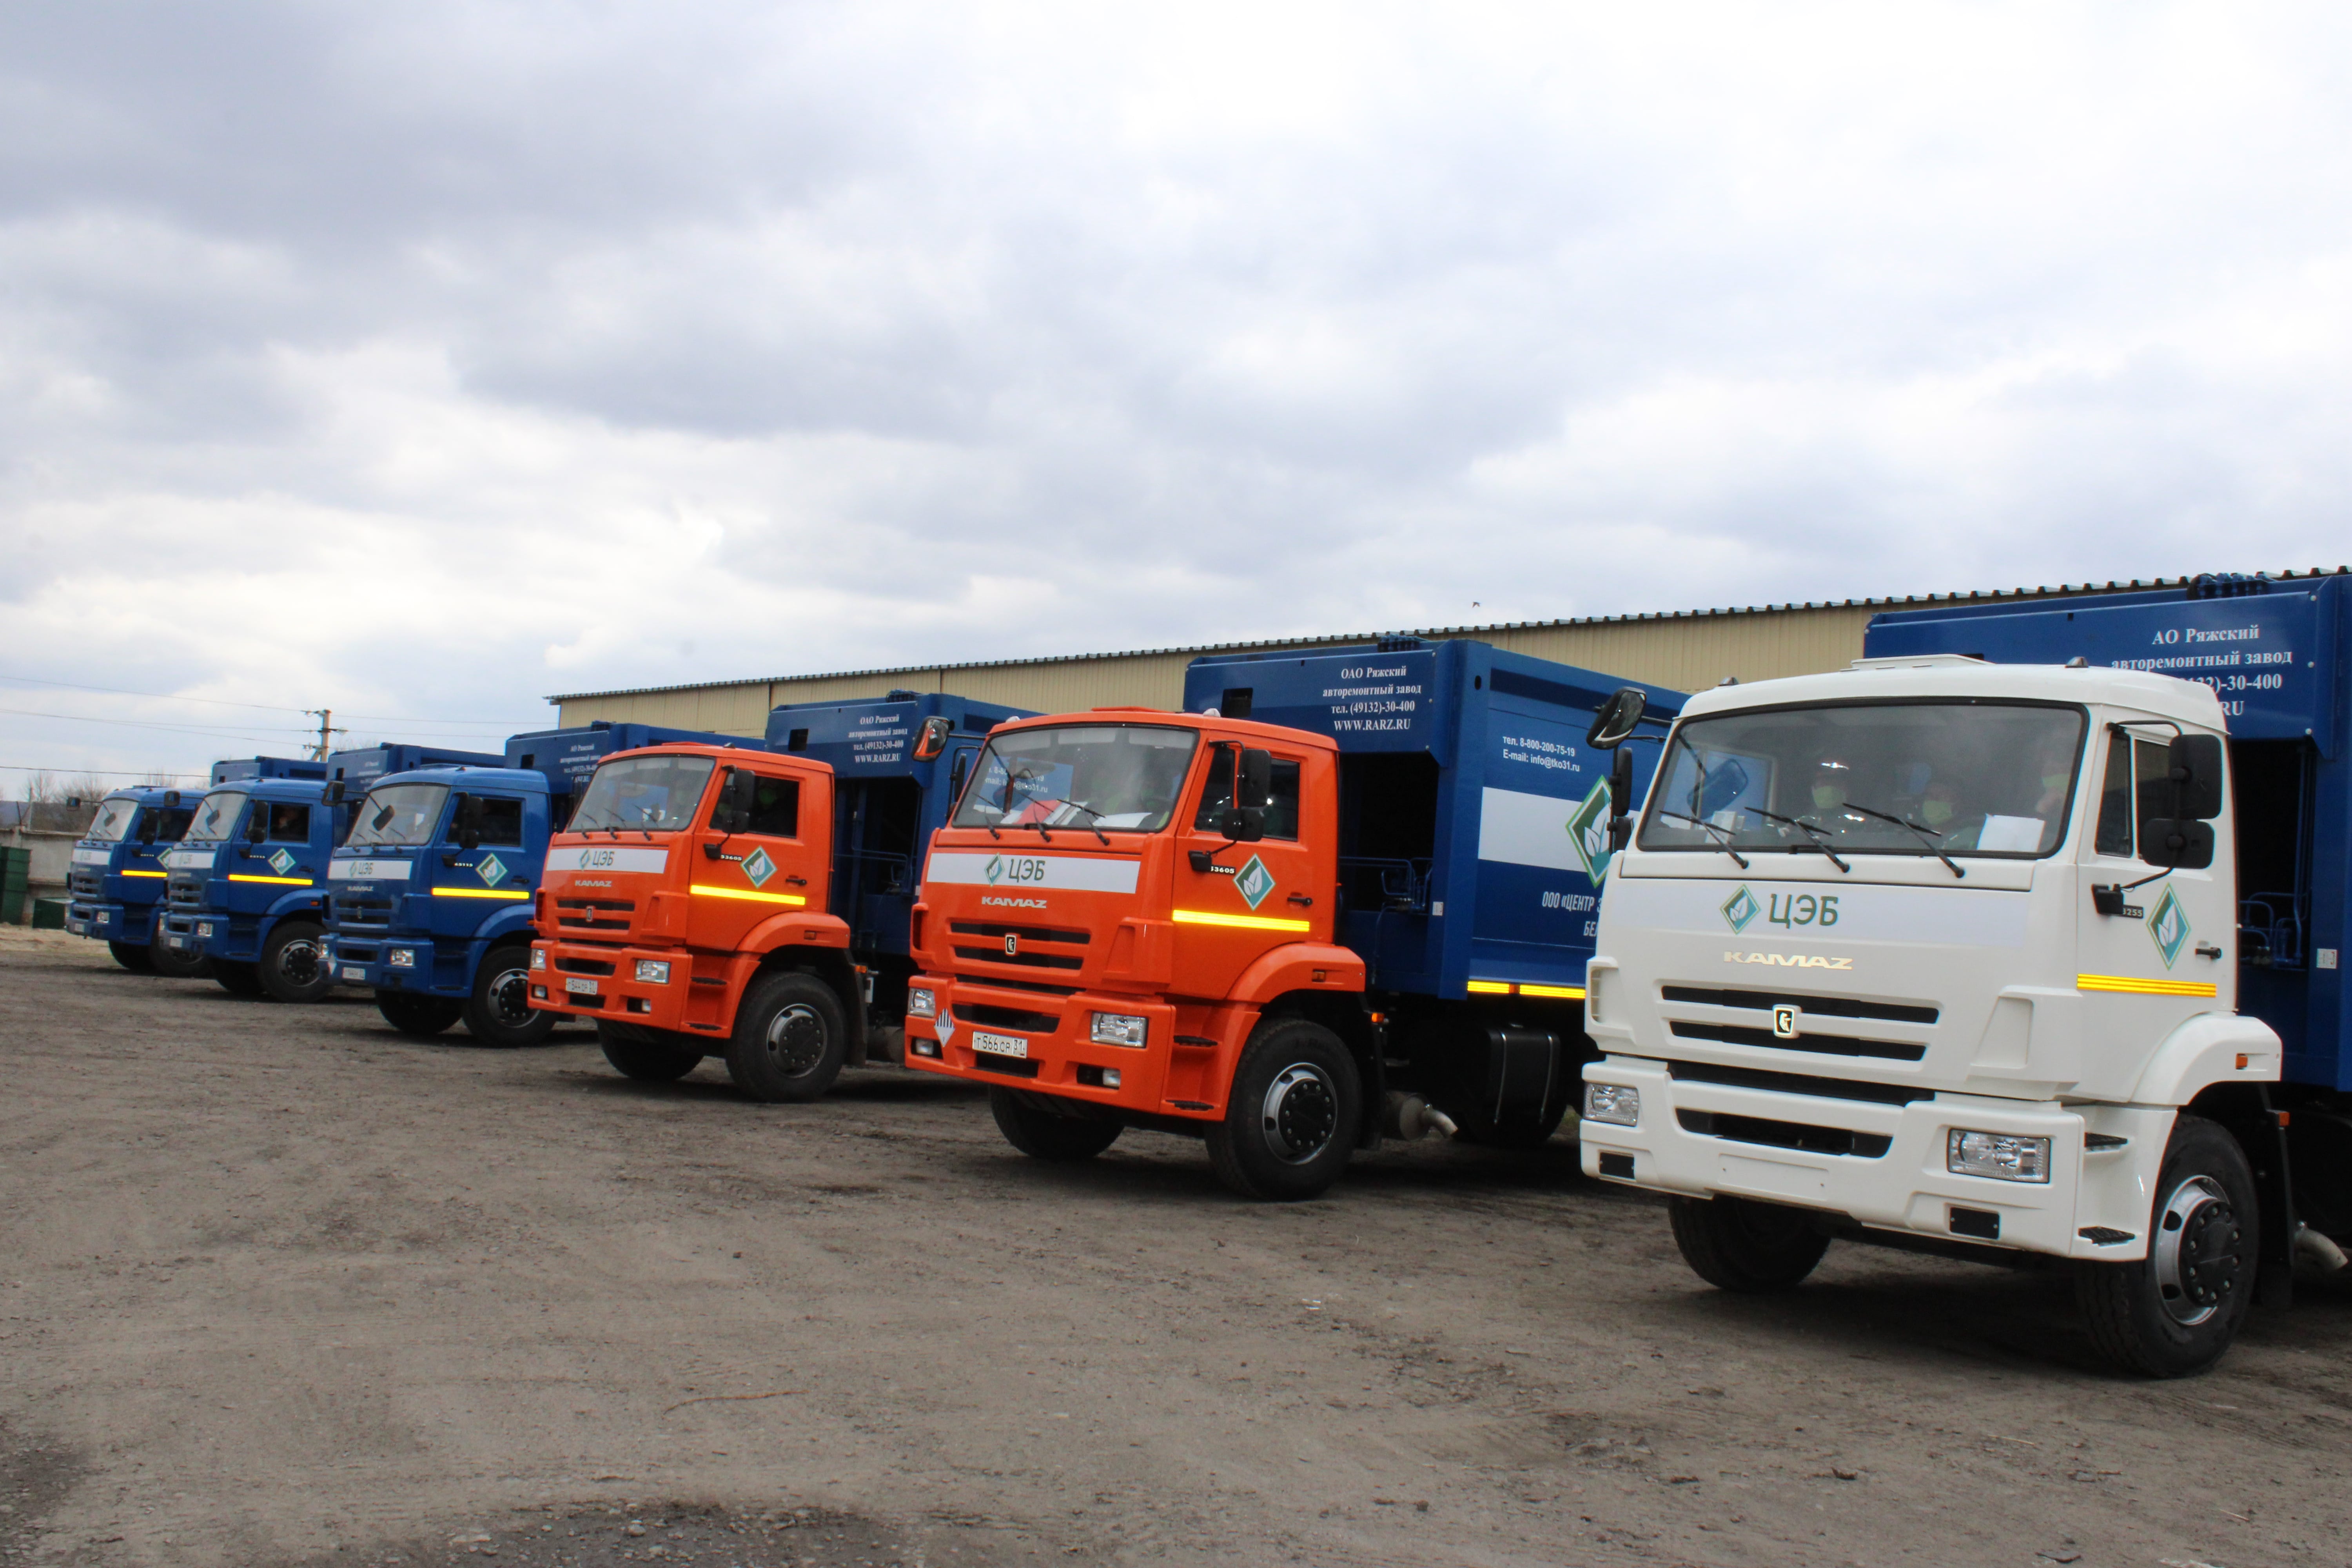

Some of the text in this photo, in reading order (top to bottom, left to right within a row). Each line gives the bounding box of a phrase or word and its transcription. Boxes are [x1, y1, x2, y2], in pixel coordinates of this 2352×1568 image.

[2151, 624, 2259, 645] АО Ряжский
[2111, 651, 2293, 671] авторемонтный завод
[1341, 666, 1406, 679] ОАО Ряжский
[1323, 684, 1421, 699] авторемонтный завод
[1350, 701, 1415, 715] (49132)-30-400
[1334, 719, 1410, 731] WWW.RARZ.RU
[1503, 736, 1575, 757] тел. 8-800-200-75-19
[855, 753, 901, 763] WWW.RARZ.RU
[1503, 749, 1580, 772] E-mail: info@tko31.ru
[592, 850, 615, 867] ЦЭБ
[1009, 858, 1045, 883] ЦЭБ
[982, 896, 1047, 909] KAMAZ
[1542, 891, 1560, 908] ООО
[1769, 893, 1839, 929] ЦЭБ
[1724, 951, 1854, 970] KAMAZ
[1014, 1040, 1024, 1051] 31
